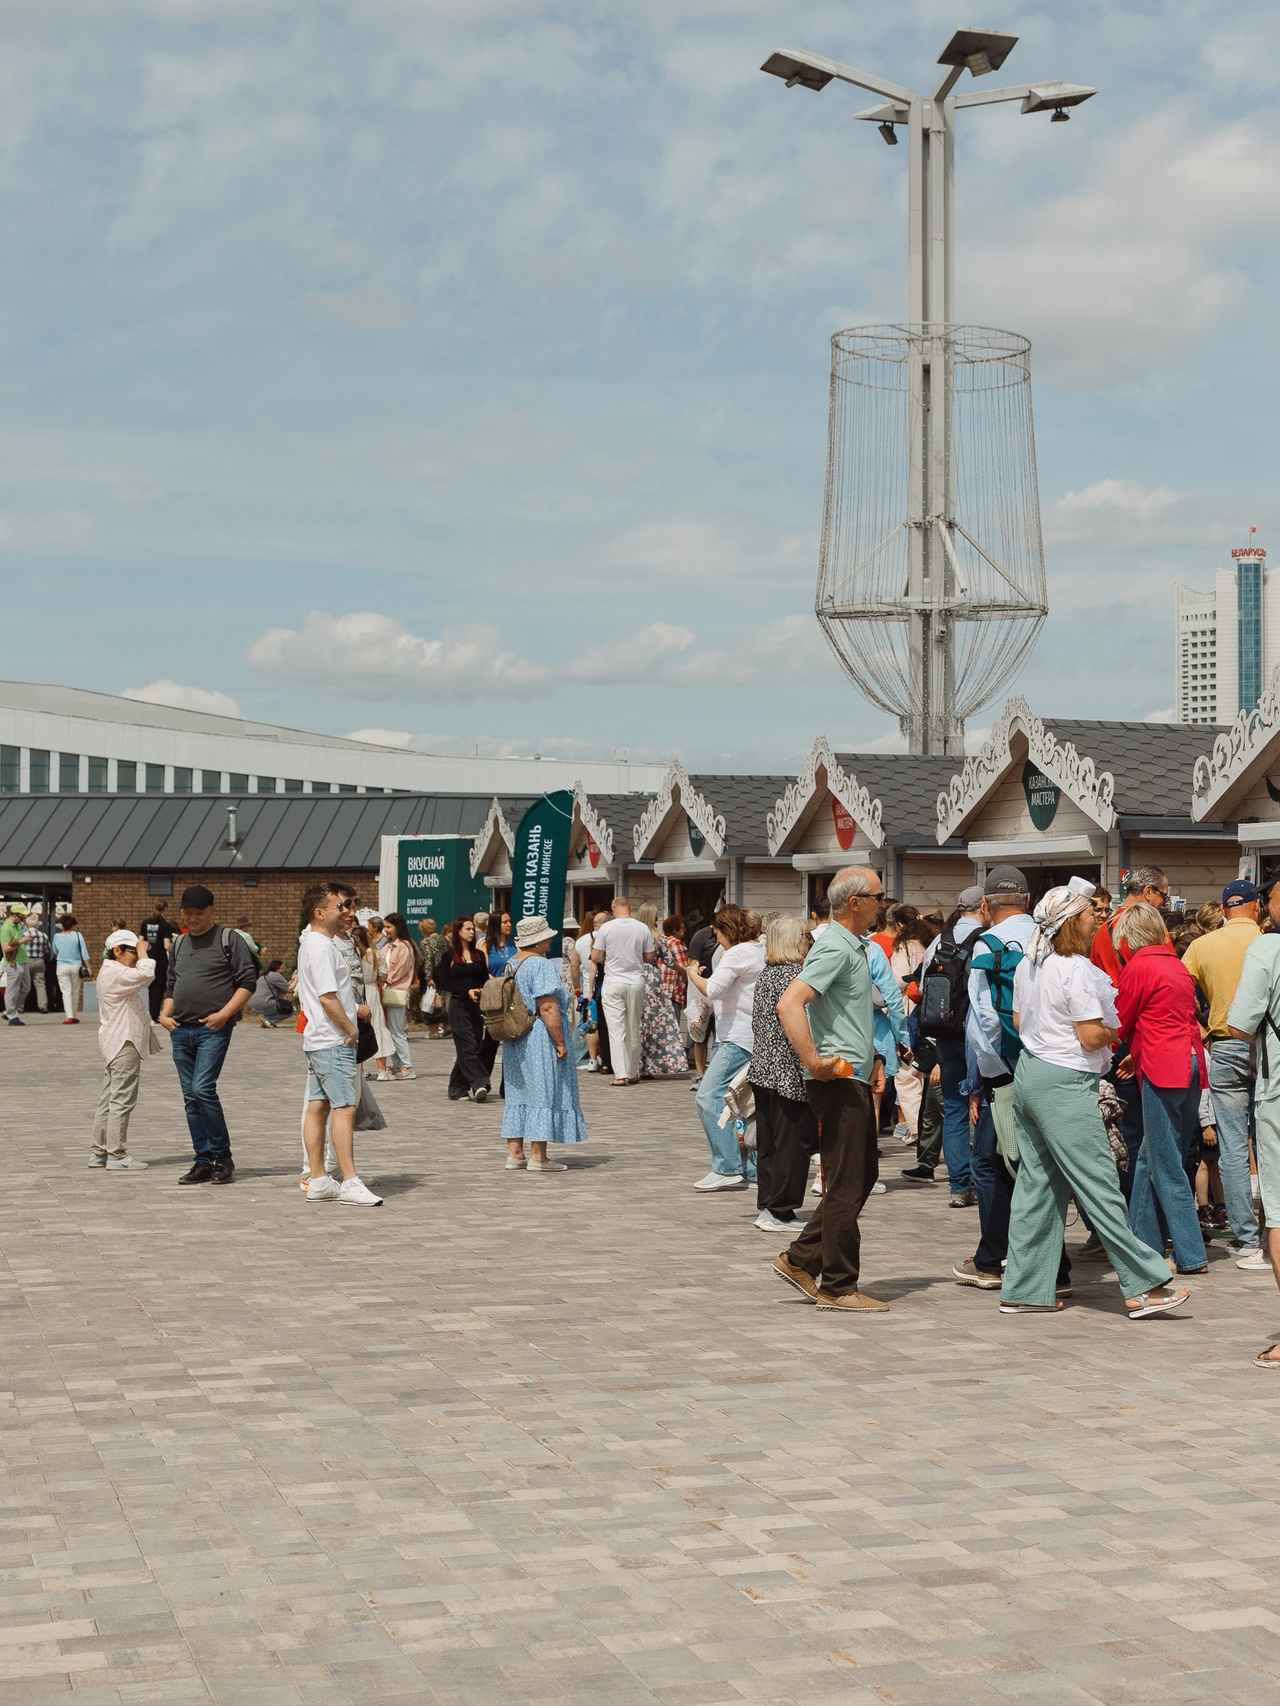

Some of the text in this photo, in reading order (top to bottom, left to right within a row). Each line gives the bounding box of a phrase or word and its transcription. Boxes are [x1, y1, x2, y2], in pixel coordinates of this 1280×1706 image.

[1231, 548, 1267, 558] БЕЛАРУСЬ
[1031, 790, 1056, 806] МАСТЕРА
[407, 855, 445, 871] ВКУСНАЯ
[541, 838, 553, 876] МИНСКЕ
[523, 824, 542, 919] СНАЯ КАЗАНЬ
[407, 873, 440, 888] КАЗАНЬ
